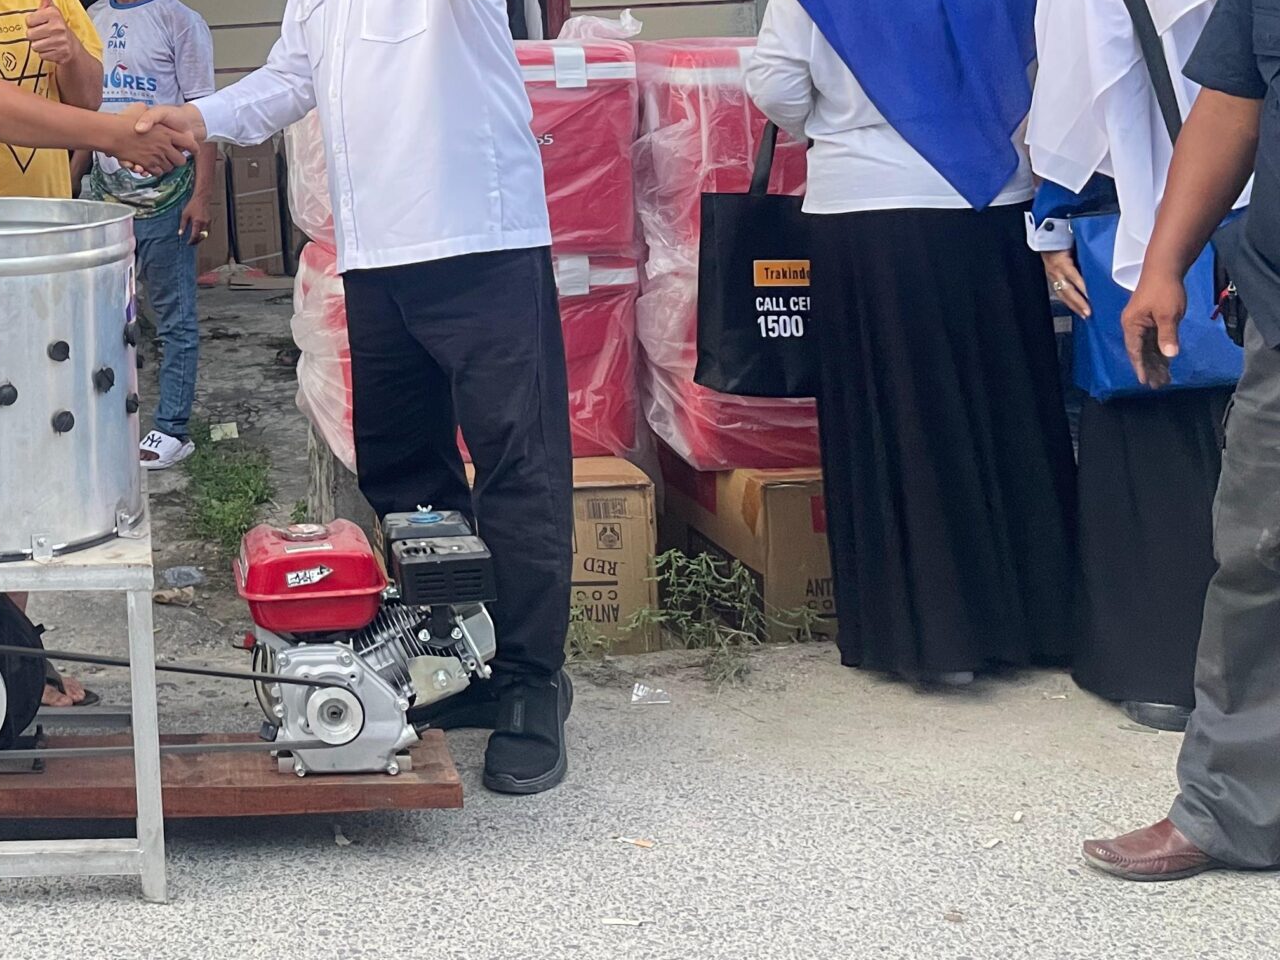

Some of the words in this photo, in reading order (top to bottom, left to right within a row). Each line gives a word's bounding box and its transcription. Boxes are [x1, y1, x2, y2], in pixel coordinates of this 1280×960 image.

[107, 40, 126, 49] PAN
[755, 297, 786, 312] CALL
[789, 296, 810, 311] CE
[757, 315, 804, 338] 1500
[583, 556, 618, 576] RED
